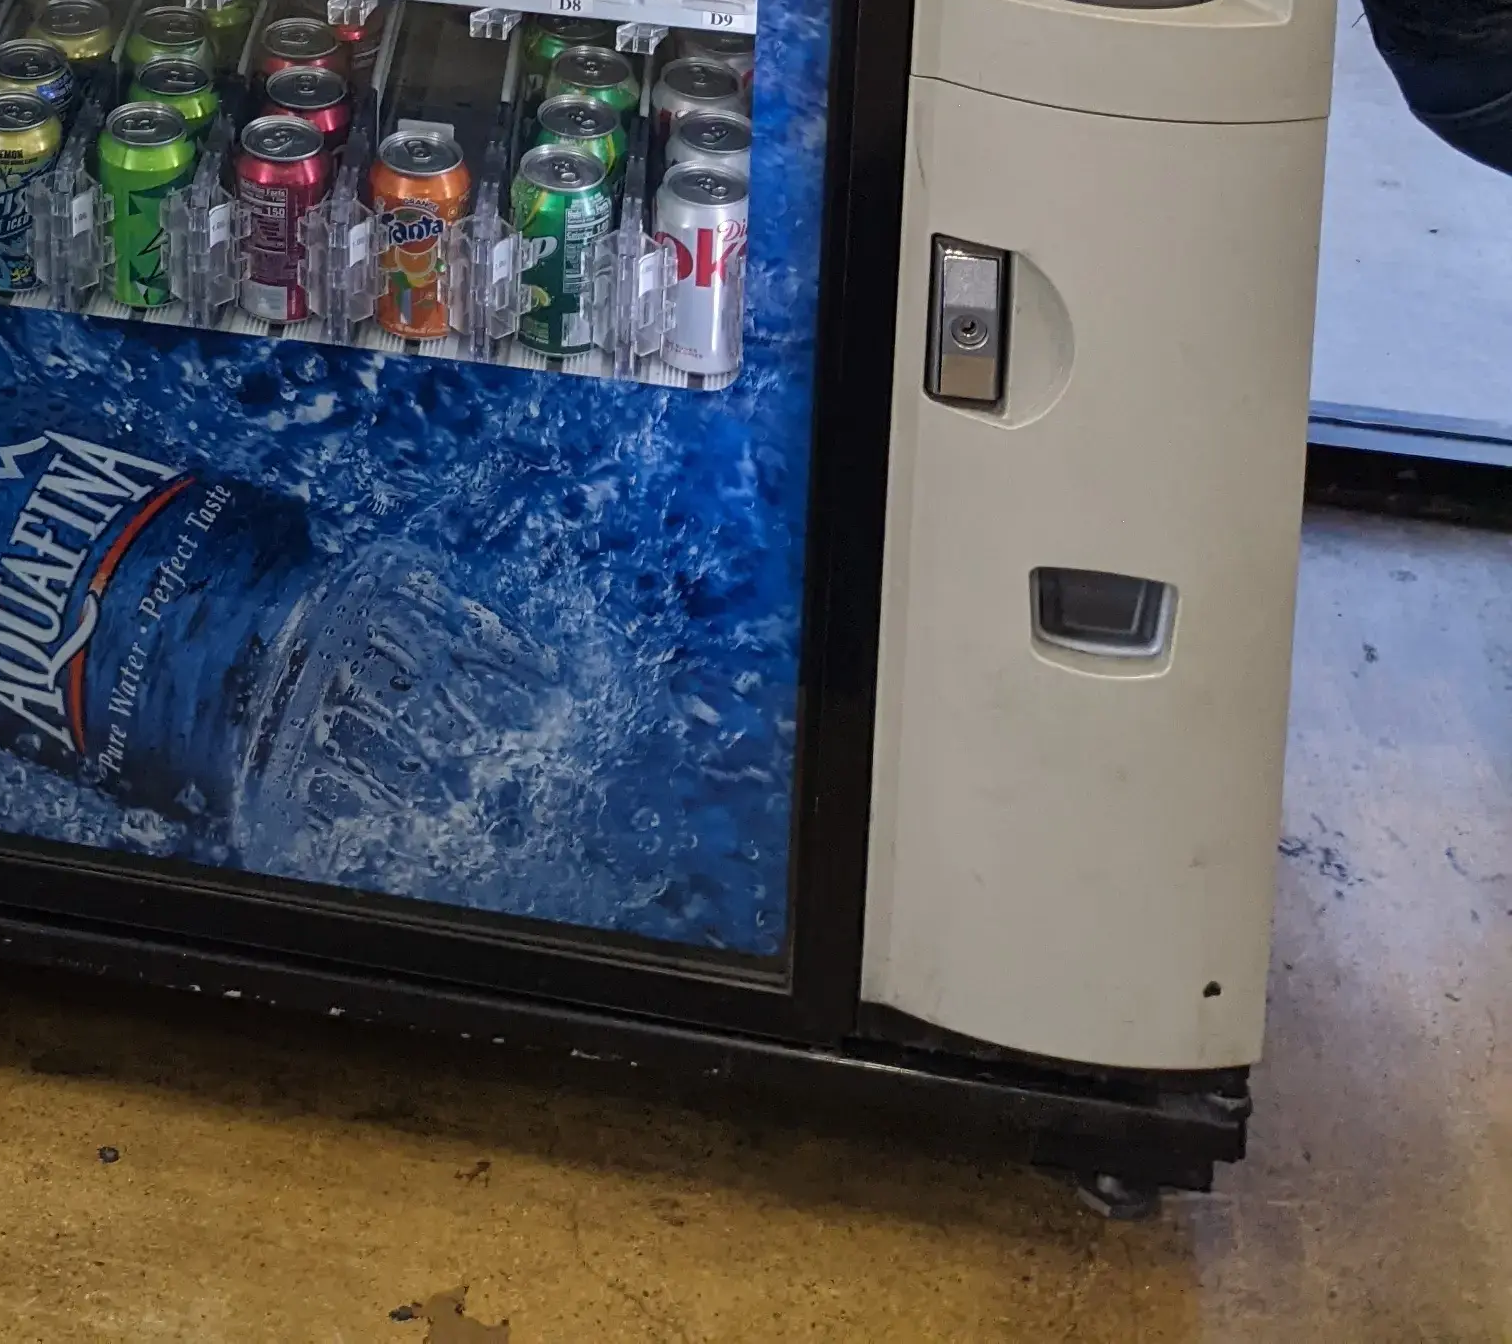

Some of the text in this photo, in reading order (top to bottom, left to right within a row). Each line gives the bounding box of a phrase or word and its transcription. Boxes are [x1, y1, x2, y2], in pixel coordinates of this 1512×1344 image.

[710, 12, 733, 27] D9
[267, 206, 285, 218] 150
[99, 481, 233, 774] Pure Water Perfect Taste
